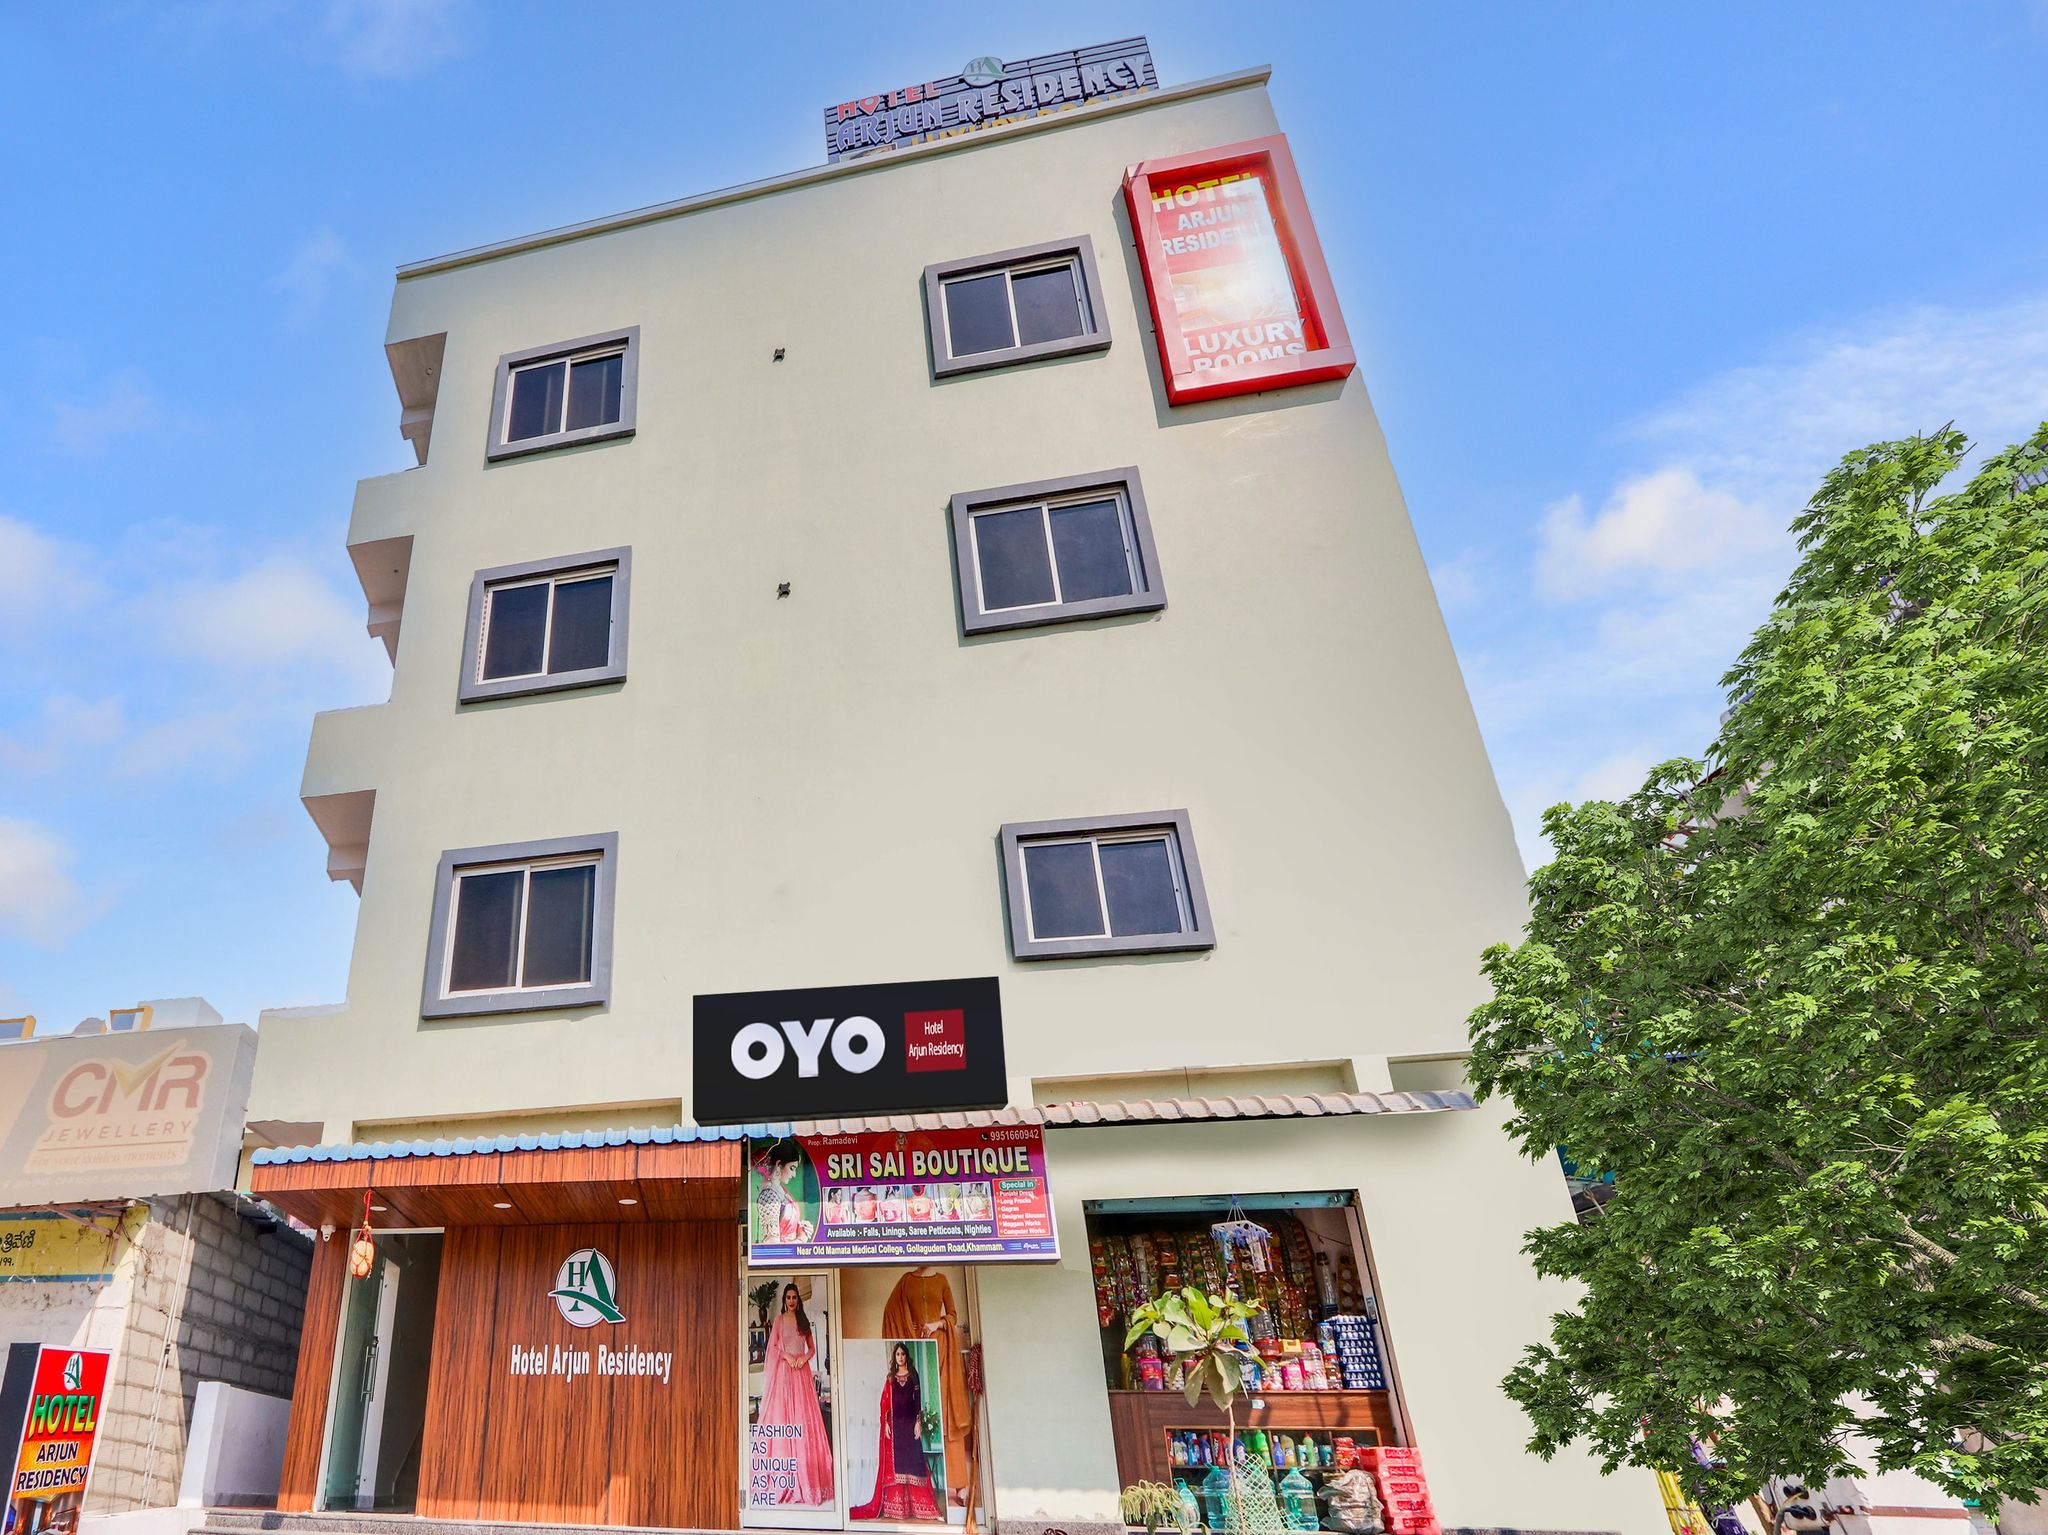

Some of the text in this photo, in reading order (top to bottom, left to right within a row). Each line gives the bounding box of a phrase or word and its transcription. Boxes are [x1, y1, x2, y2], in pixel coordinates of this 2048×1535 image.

[835, 99, 943, 151] ARJUN
[957, 55, 1151, 123] RESIDENCY
[837, 82, 942, 123] HOTEL
[1184, 317, 1305, 356] LUXURY
[924, 1019, 944, 1035] Hotel
[731, 1016, 886, 1079] OYO
[908, 1041, 964, 1060] Arjun Residency
[52, 1039, 208, 1118] CMR
[43, 1121, 192, 1143] JEWELLERY
[822, 1136, 858, 1146] Ramadevi
[990, 1129, 1040, 1141] 9951660942
[827, 1146, 1030, 1180] SRI SAI BOUTIQUE
[1001, 1181, 1026, 1190] Special
[827, 1227, 856, 1238] Available
[881, 1226, 908, 1237] Linings,
[909, 1225, 928, 1236] Saree
[928, 1224, 963, 1236] Petticoats,
[964, 1223, 992, 1236] Nighties
[796, 1246, 811, 1256] Near
[812, 1245, 825, 1255] Old
[826, 1245, 851, 1255] Mamata
[852, 1244, 877, 1254] Medical
[878, 1243, 905, 1256] College,
[906, 1243, 946, 1255] Gollagudem
[511, 1344, 673, 1385] Hotel Arjun Residency
[28, 1394, 97, 1440] HOTEL
[751, 1425, 802, 1438] FASHION
[36, 1441, 80, 1463] ARJUN
[751, 1441, 767, 1454] AS
[752, 1458, 797, 1472] UNIQUE
[16, 1465, 89, 1491] RESIDENCY
[751, 1475, 796, 1489] AS YOU
[751, 1492, 776, 1506] ARE
